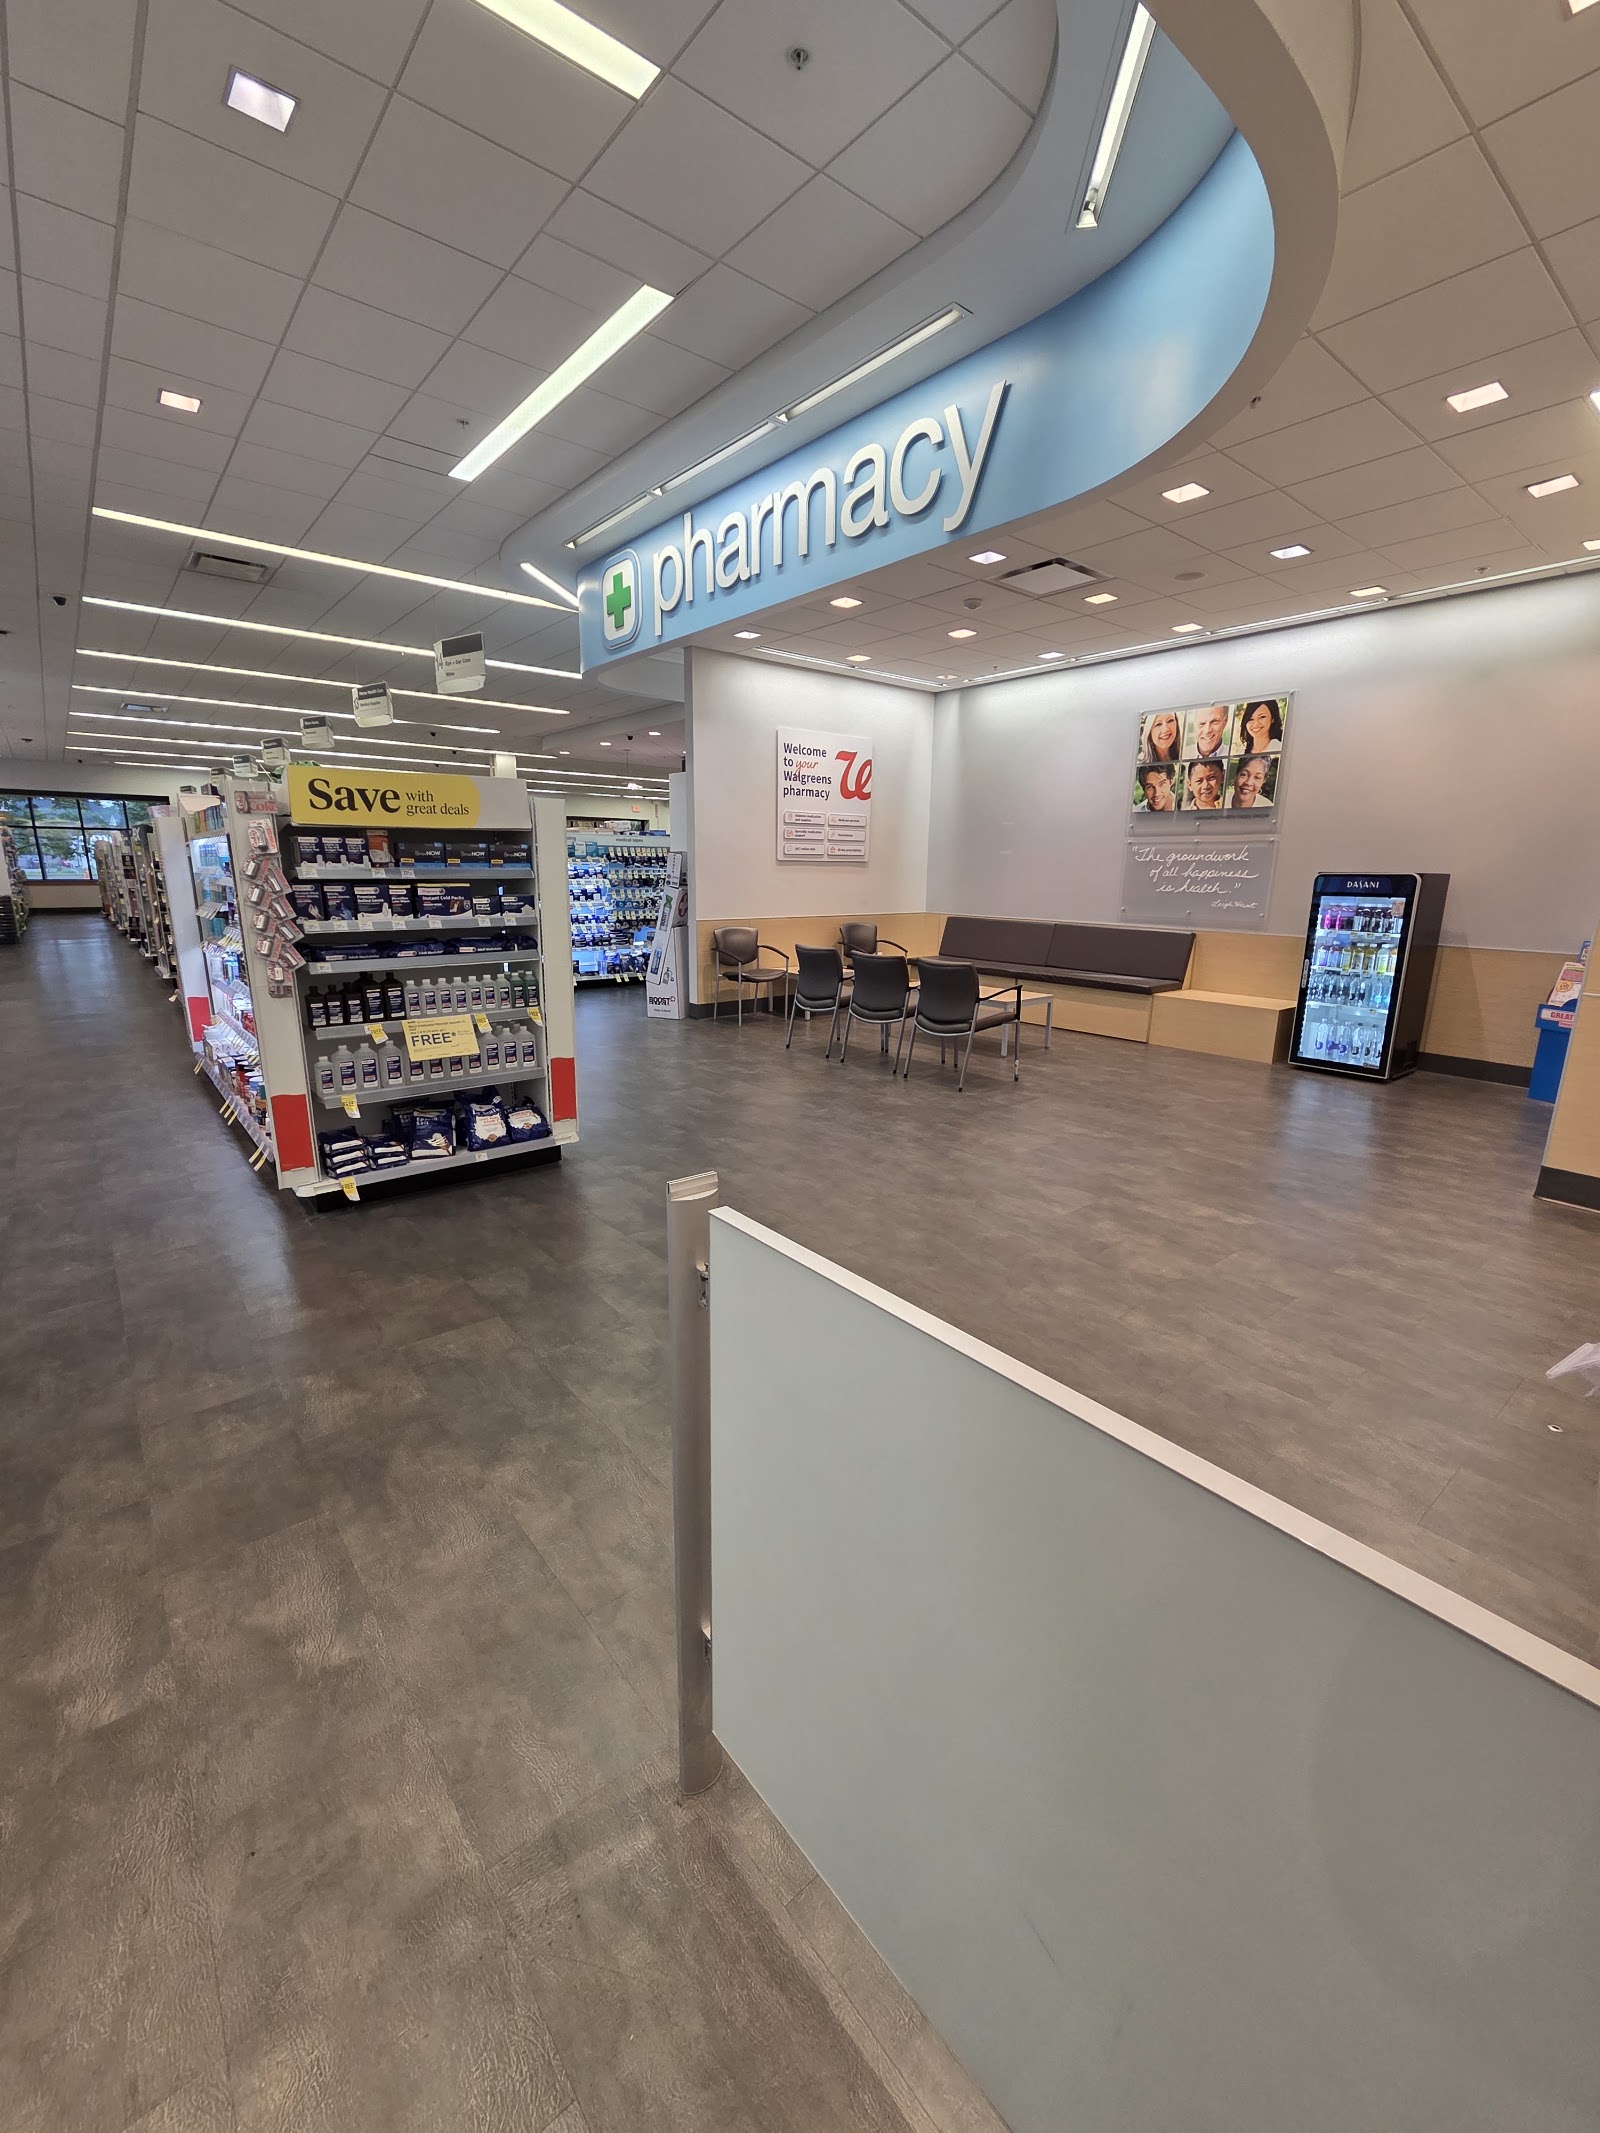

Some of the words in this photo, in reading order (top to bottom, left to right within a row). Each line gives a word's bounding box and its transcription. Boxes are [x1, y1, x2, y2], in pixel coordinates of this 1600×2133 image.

[652, 380, 1007, 637] pharmacy
[783, 743, 827, 757] Welcome
[784, 756, 793, 767] to
[795, 759, 818, 775] your
[783, 770, 832, 785] Walgreens
[307, 778, 401, 814] Save
[406, 790, 434, 802] with
[783, 785, 830, 801] pharmacy
[406, 803, 437, 816] great
[440, 802, 469, 815] deals
[1166, 845, 1249, 867] groundwork
[1150, 865, 1161, 882] of
[1162, 866, 1178, 876] all
[1181, 863, 1259, 880] happiness
[1156, 882, 1175, 892] is
[1347, 880, 1379, 889] DASANI
